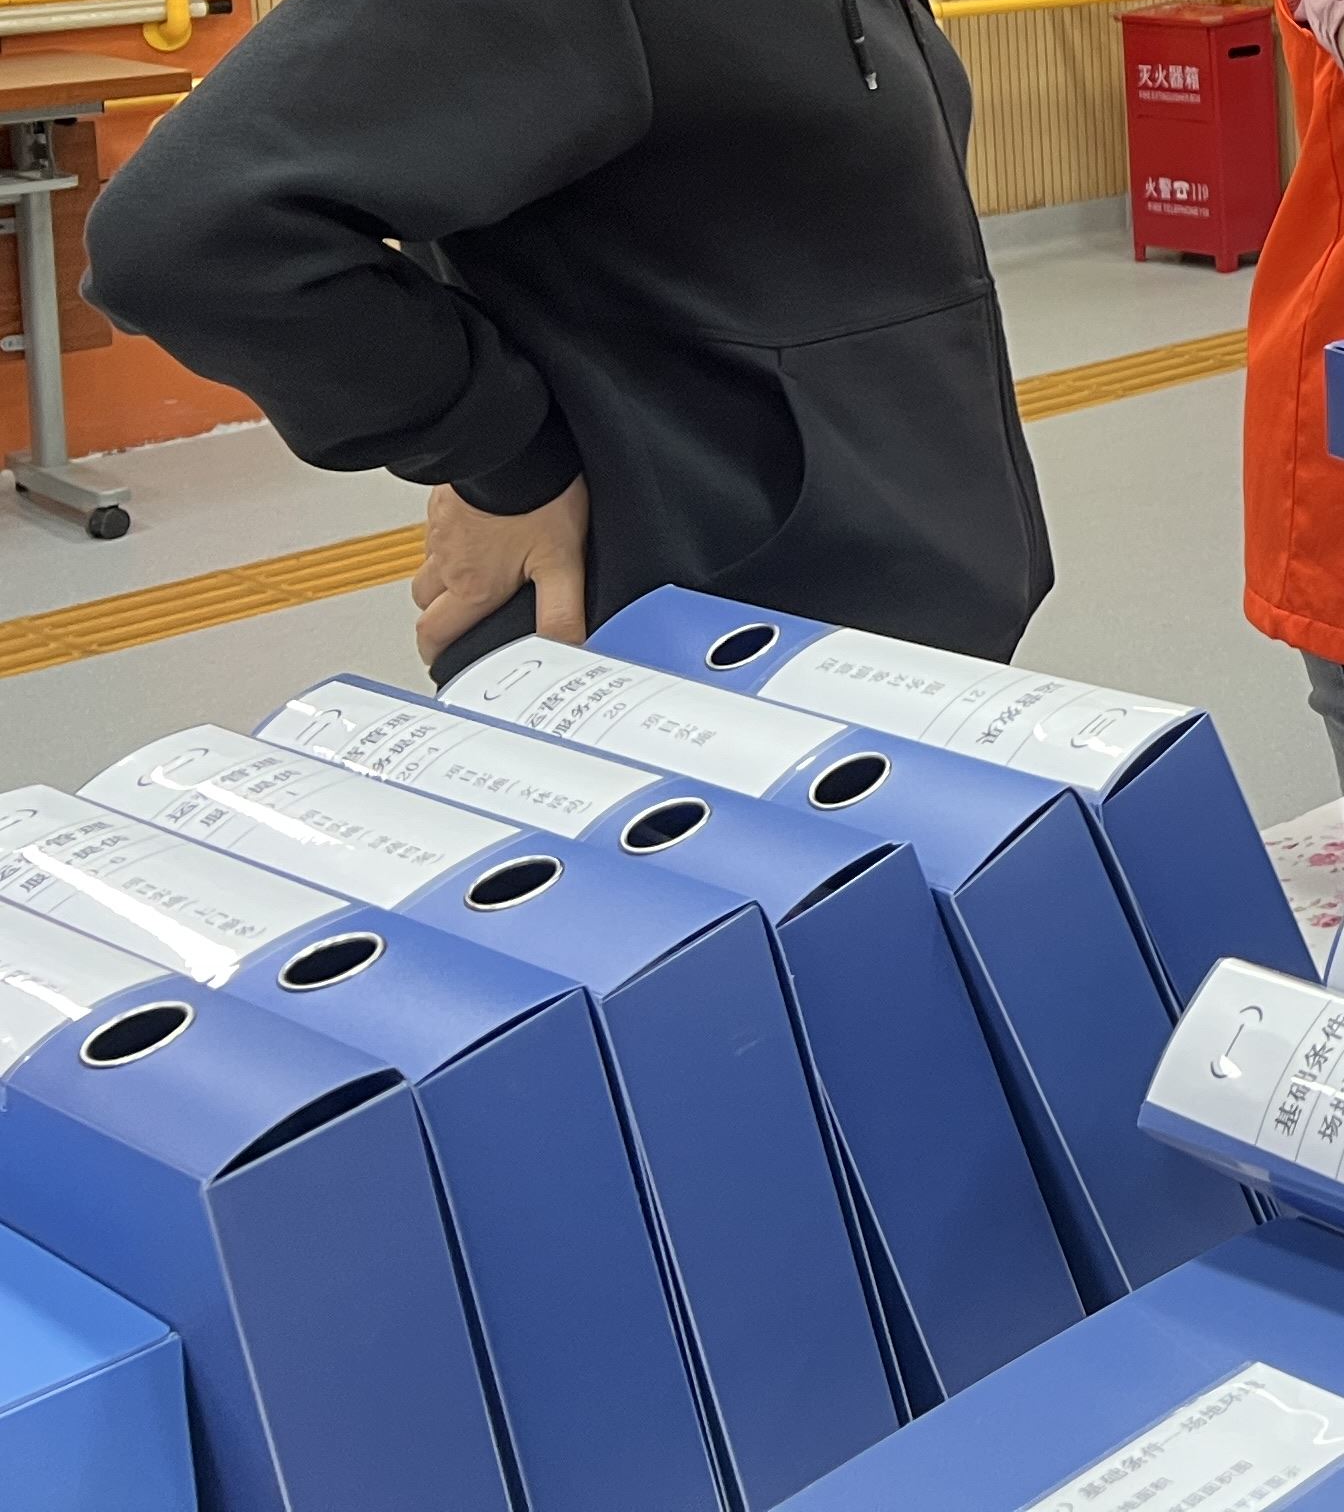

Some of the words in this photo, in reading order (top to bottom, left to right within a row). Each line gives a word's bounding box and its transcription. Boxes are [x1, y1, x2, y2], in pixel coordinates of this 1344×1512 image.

[1138, 63, 1200, 90] 灭火器箱
[603, 702, 628, 721] 20
